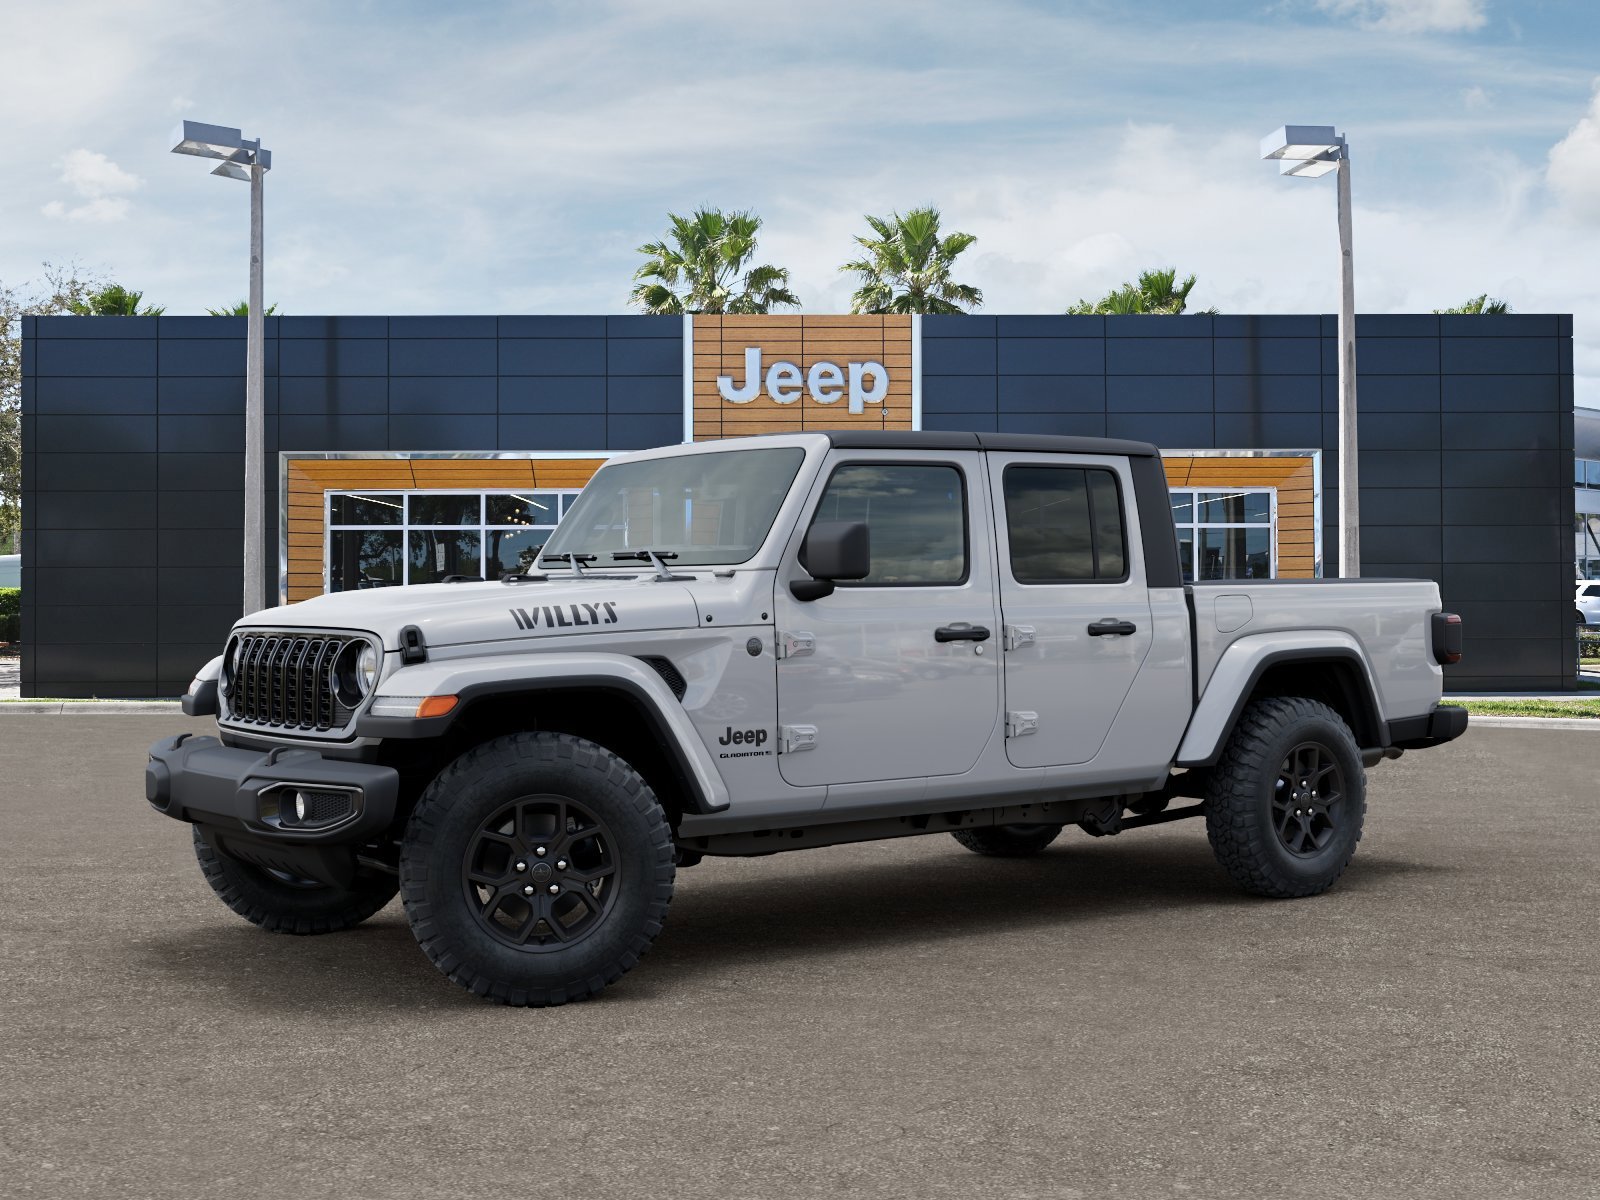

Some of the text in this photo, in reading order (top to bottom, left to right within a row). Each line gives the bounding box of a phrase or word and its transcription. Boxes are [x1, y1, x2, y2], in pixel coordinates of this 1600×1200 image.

[716, 347, 890, 415] Jeep
[509, 601, 618, 630] WILLYS
[719, 726, 768, 747] Jeep
[720, 751, 764, 759] GLADIATOR
